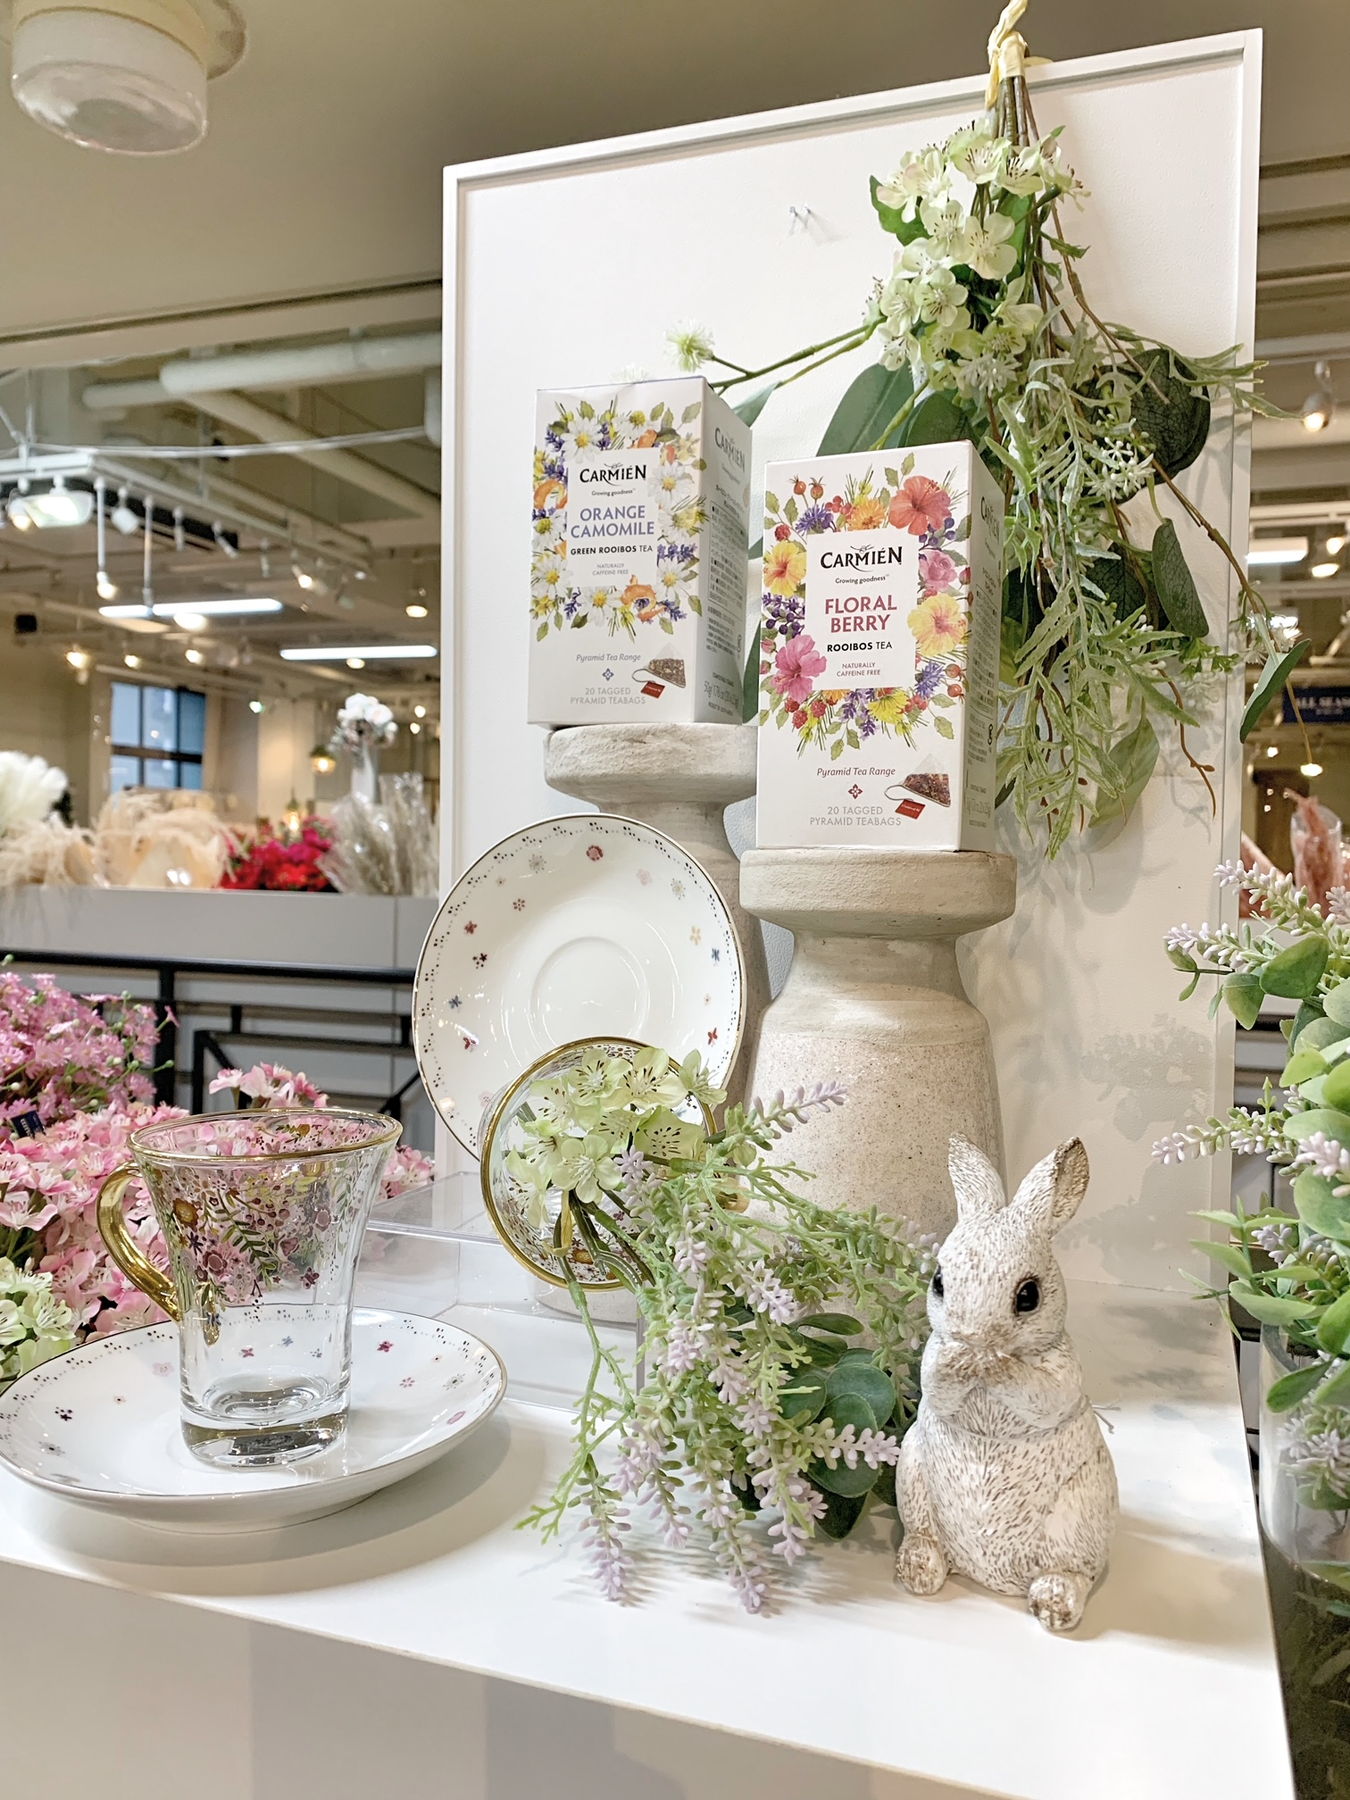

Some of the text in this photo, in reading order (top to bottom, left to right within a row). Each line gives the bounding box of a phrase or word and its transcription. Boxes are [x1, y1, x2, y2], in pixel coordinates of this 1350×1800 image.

[580, 505, 646, 521] ORANGE
[570, 522, 655, 539] CAMOMILE
[570, 547, 596, 555] GREEN
[599, 545, 637, 554] ROOIBOS
[820, 546, 903, 572] CARMIÉN
[835, 577, 858, 585] Growing
[825, 595, 897, 614] FLORAL
[831, 614, 891, 633] BERRY
[827, 641, 893, 652] ROOIBOS TEA
[576, 654, 605, 663] Pyramid
[619, 653, 641, 662] Range
[597, 687, 631, 695] TAGGED
[570, 696, 647, 705] PYRAMID TEABAGS
[817, 767, 896, 778] Pyramid Tea Range
[827, 806, 883, 815] 20 TAGGED
[809, 817, 902, 826] PYRAMID TEABAGS
